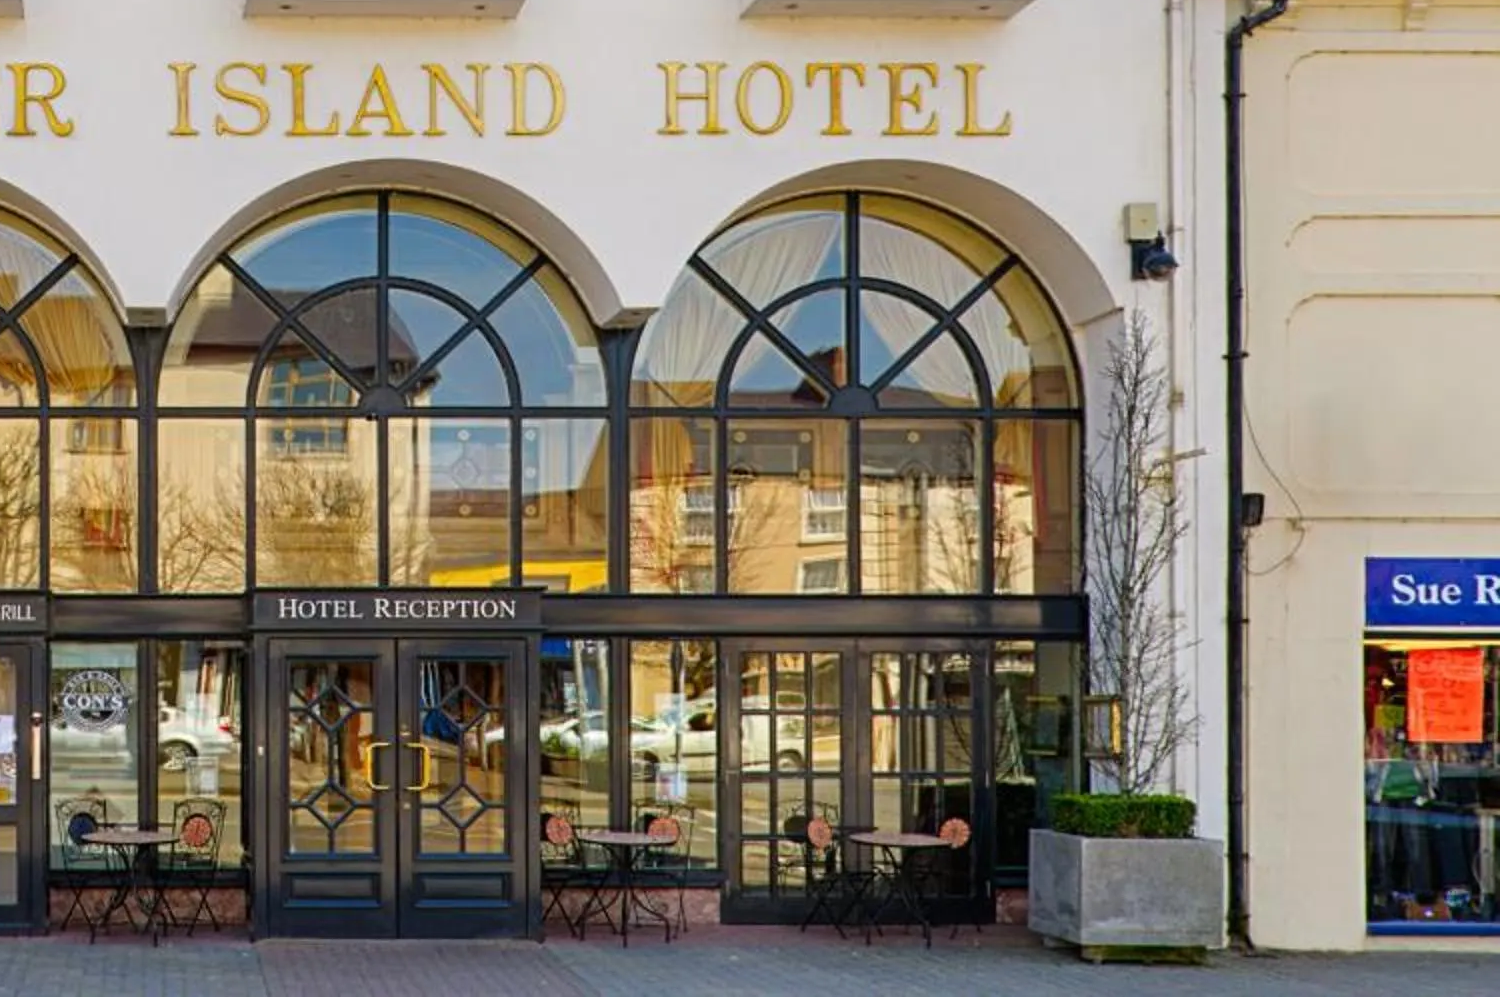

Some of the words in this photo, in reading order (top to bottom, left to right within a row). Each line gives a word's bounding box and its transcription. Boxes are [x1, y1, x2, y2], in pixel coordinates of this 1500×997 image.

[168, 61, 566, 138] ISLAND
[658, 60, 1012, 137] HOTEL
[1392, 574, 1462, 605] Sue
[63, 695, 123, 710] CON'S
